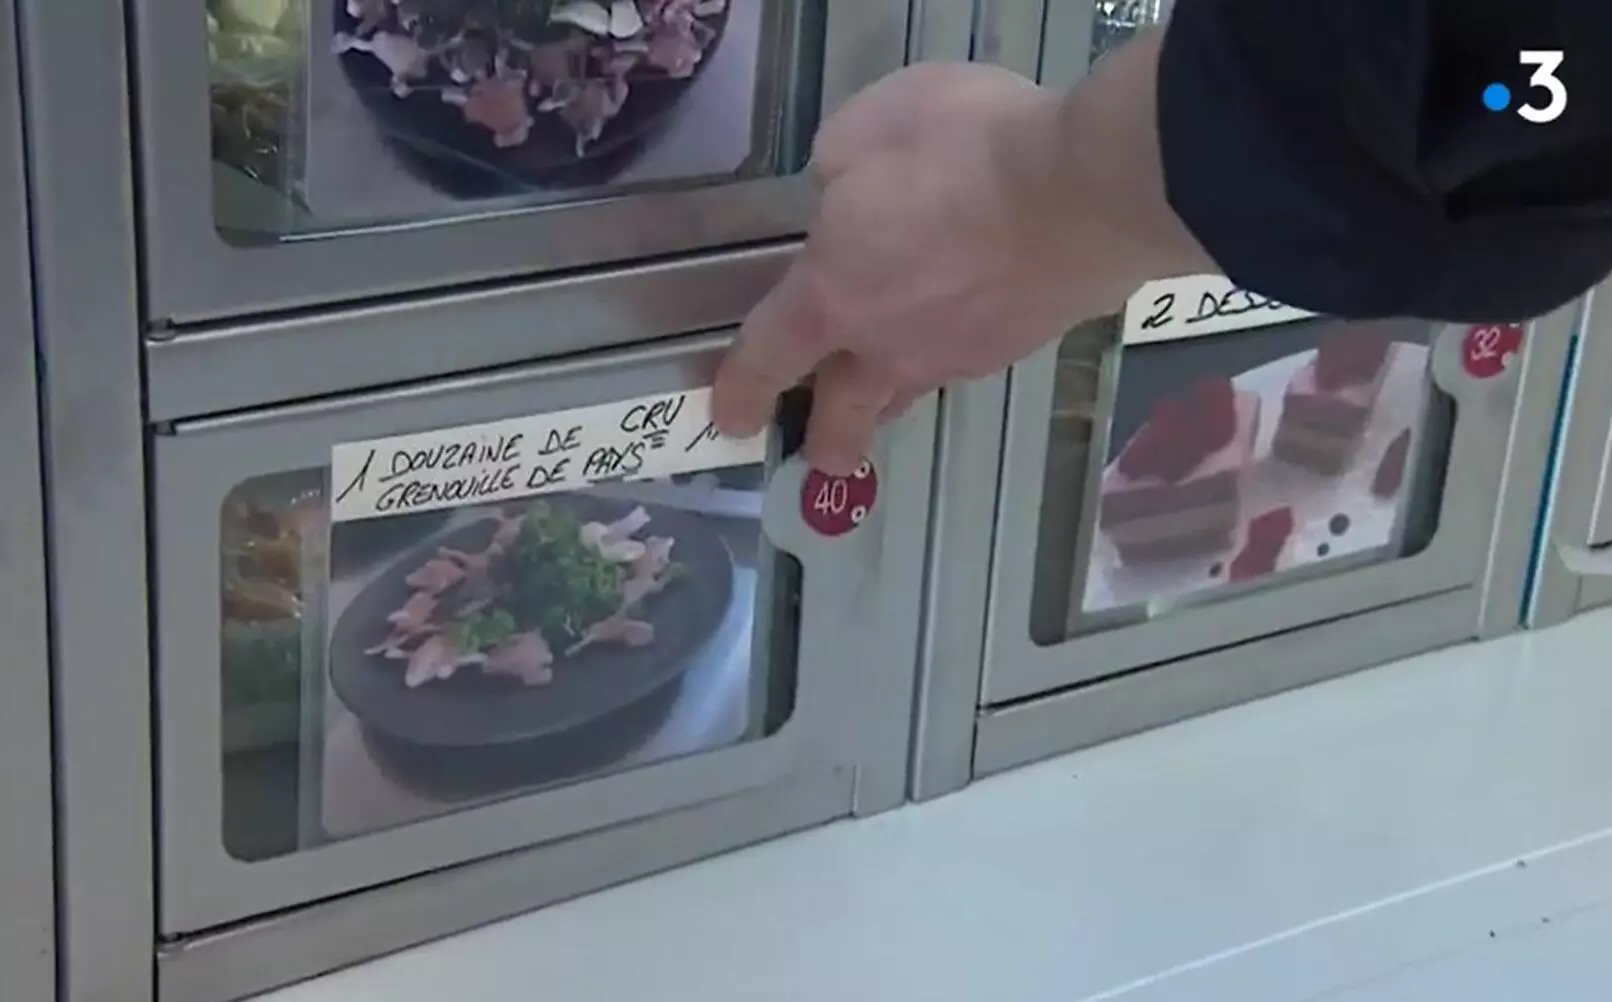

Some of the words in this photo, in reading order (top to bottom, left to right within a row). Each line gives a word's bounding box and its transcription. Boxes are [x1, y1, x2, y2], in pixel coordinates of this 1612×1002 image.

[1141, 293, 1176, 330] 2
[1185, 287, 1284, 324] DES
[1470, 326, 1501, 361] 32
[335, 449, 376, 503] 1
[378, 433, 524, 483] DOUZAINE
[538, 425, 583, 455] DE
[620, 395, 686, 432] CRU
[375, 463, 521, 511] GRENOUILLE
[526, 457, 571, 489] DE
[582, 441, 646, 476] PAYS
[813, 478, 848, 516] 40
